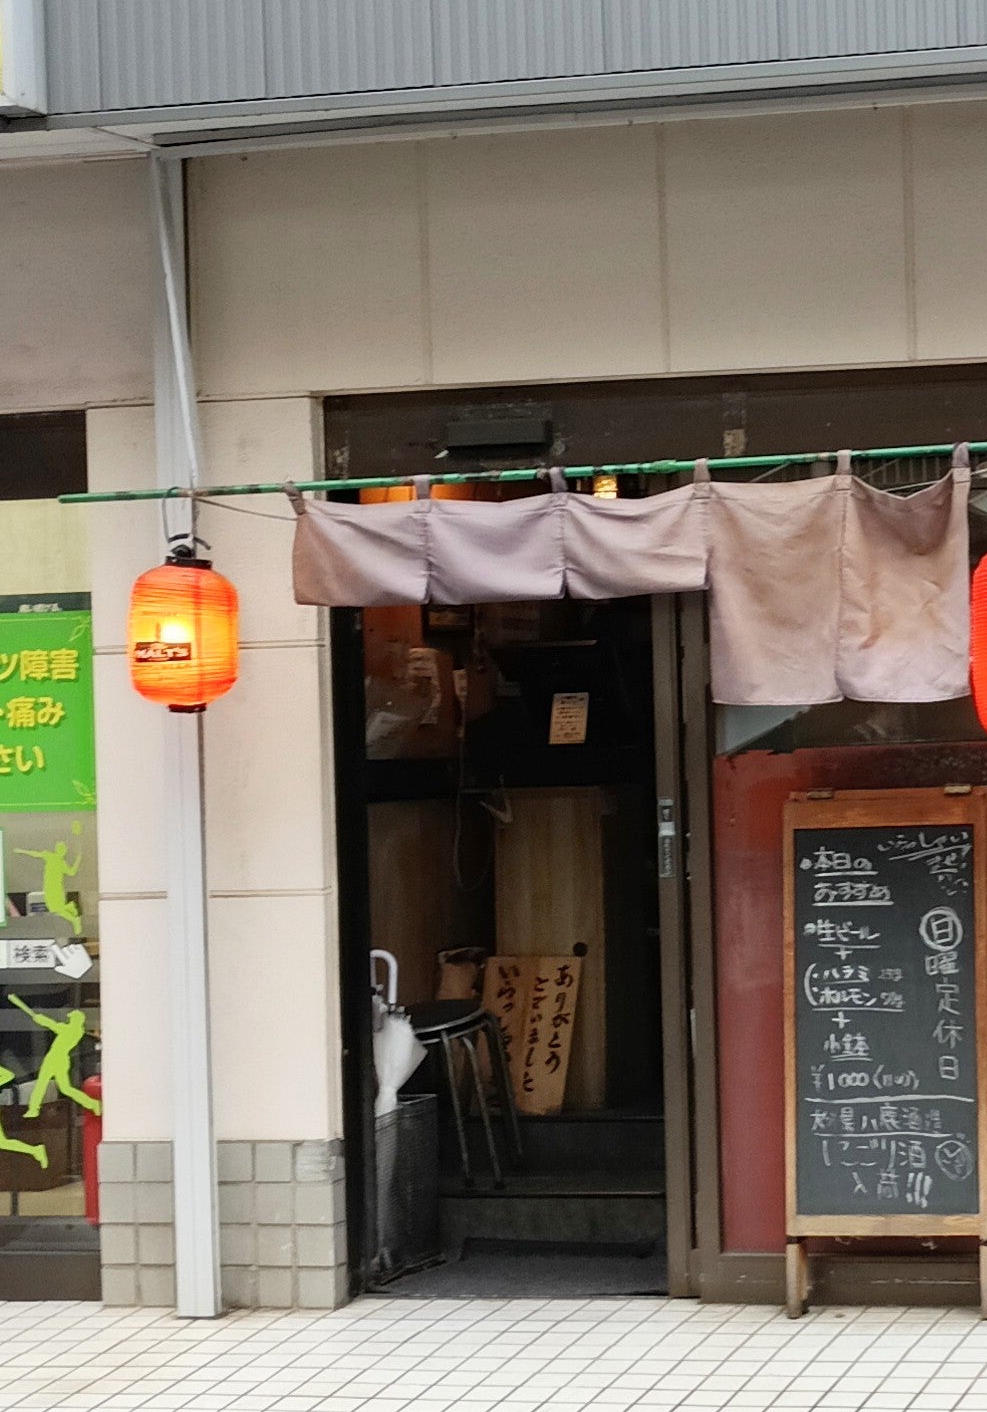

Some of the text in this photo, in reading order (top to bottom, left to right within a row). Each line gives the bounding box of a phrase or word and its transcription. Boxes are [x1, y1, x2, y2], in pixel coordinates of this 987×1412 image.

[812, 846, 873, 871] 本日の
[814, 881, 892, 903] おすすめ
[816, 919, 881, 942] 生ビール
[544, 964, 574, 1075] ありがとう
